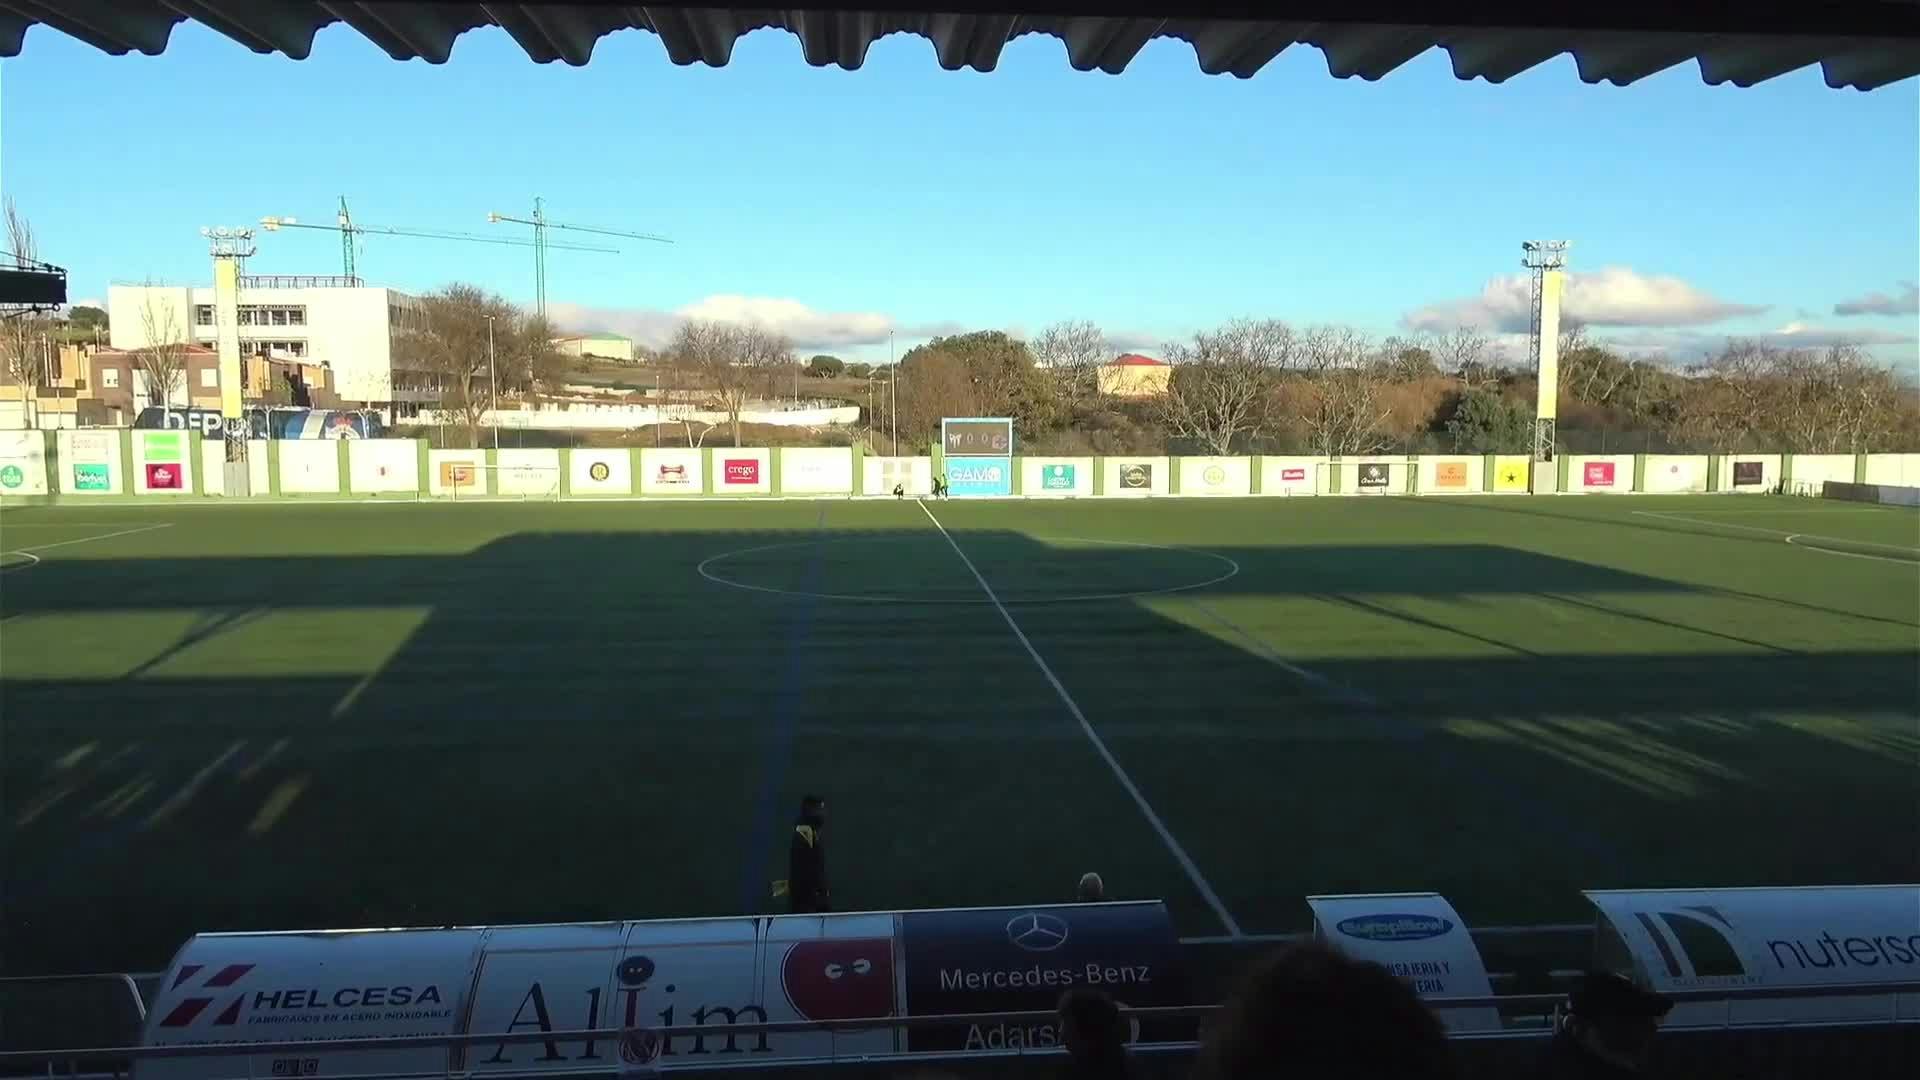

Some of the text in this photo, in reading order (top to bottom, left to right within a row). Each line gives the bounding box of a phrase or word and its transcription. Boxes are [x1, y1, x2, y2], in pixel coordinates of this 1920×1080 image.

[728, 465, 755, 476] crego
[939, 963, 1153, 990] Mercedes-Benz
[254, 985, 441, 1009] HELCESA
[323, 1014, 339, 1024] EN
[342, 1012, 381, 1023] ACERO
